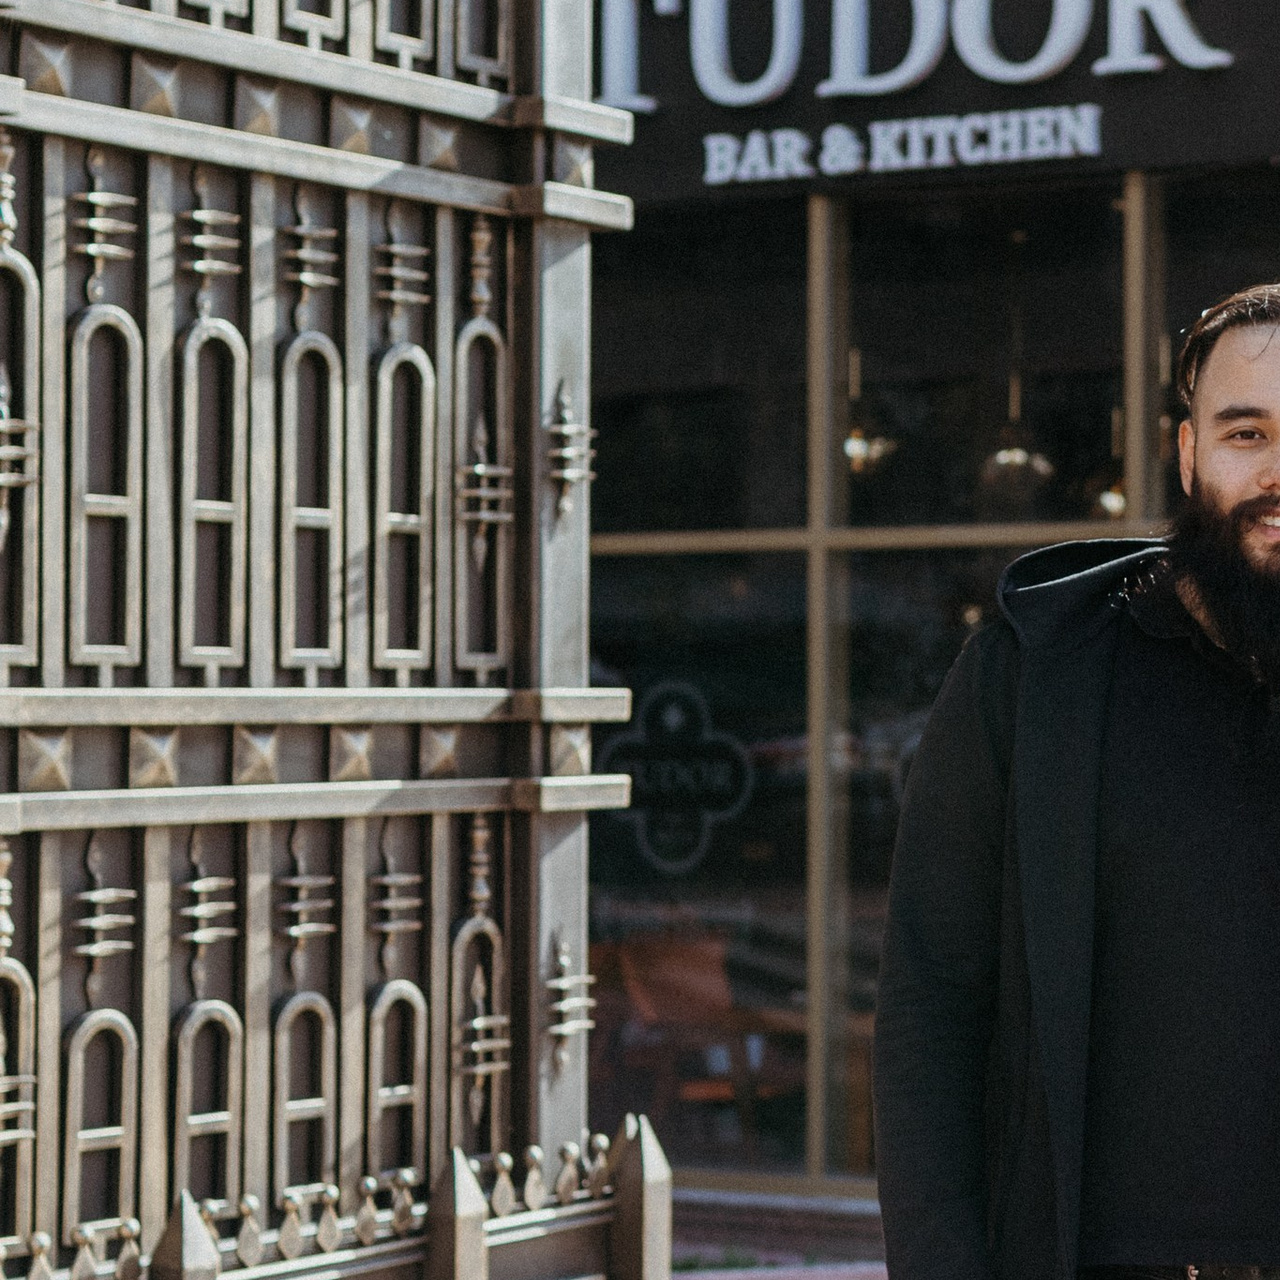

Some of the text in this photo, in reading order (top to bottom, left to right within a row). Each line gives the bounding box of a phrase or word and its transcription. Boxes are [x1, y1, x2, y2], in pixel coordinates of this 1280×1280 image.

[702, 102, 1102, 185] BAR & KITCHEN
